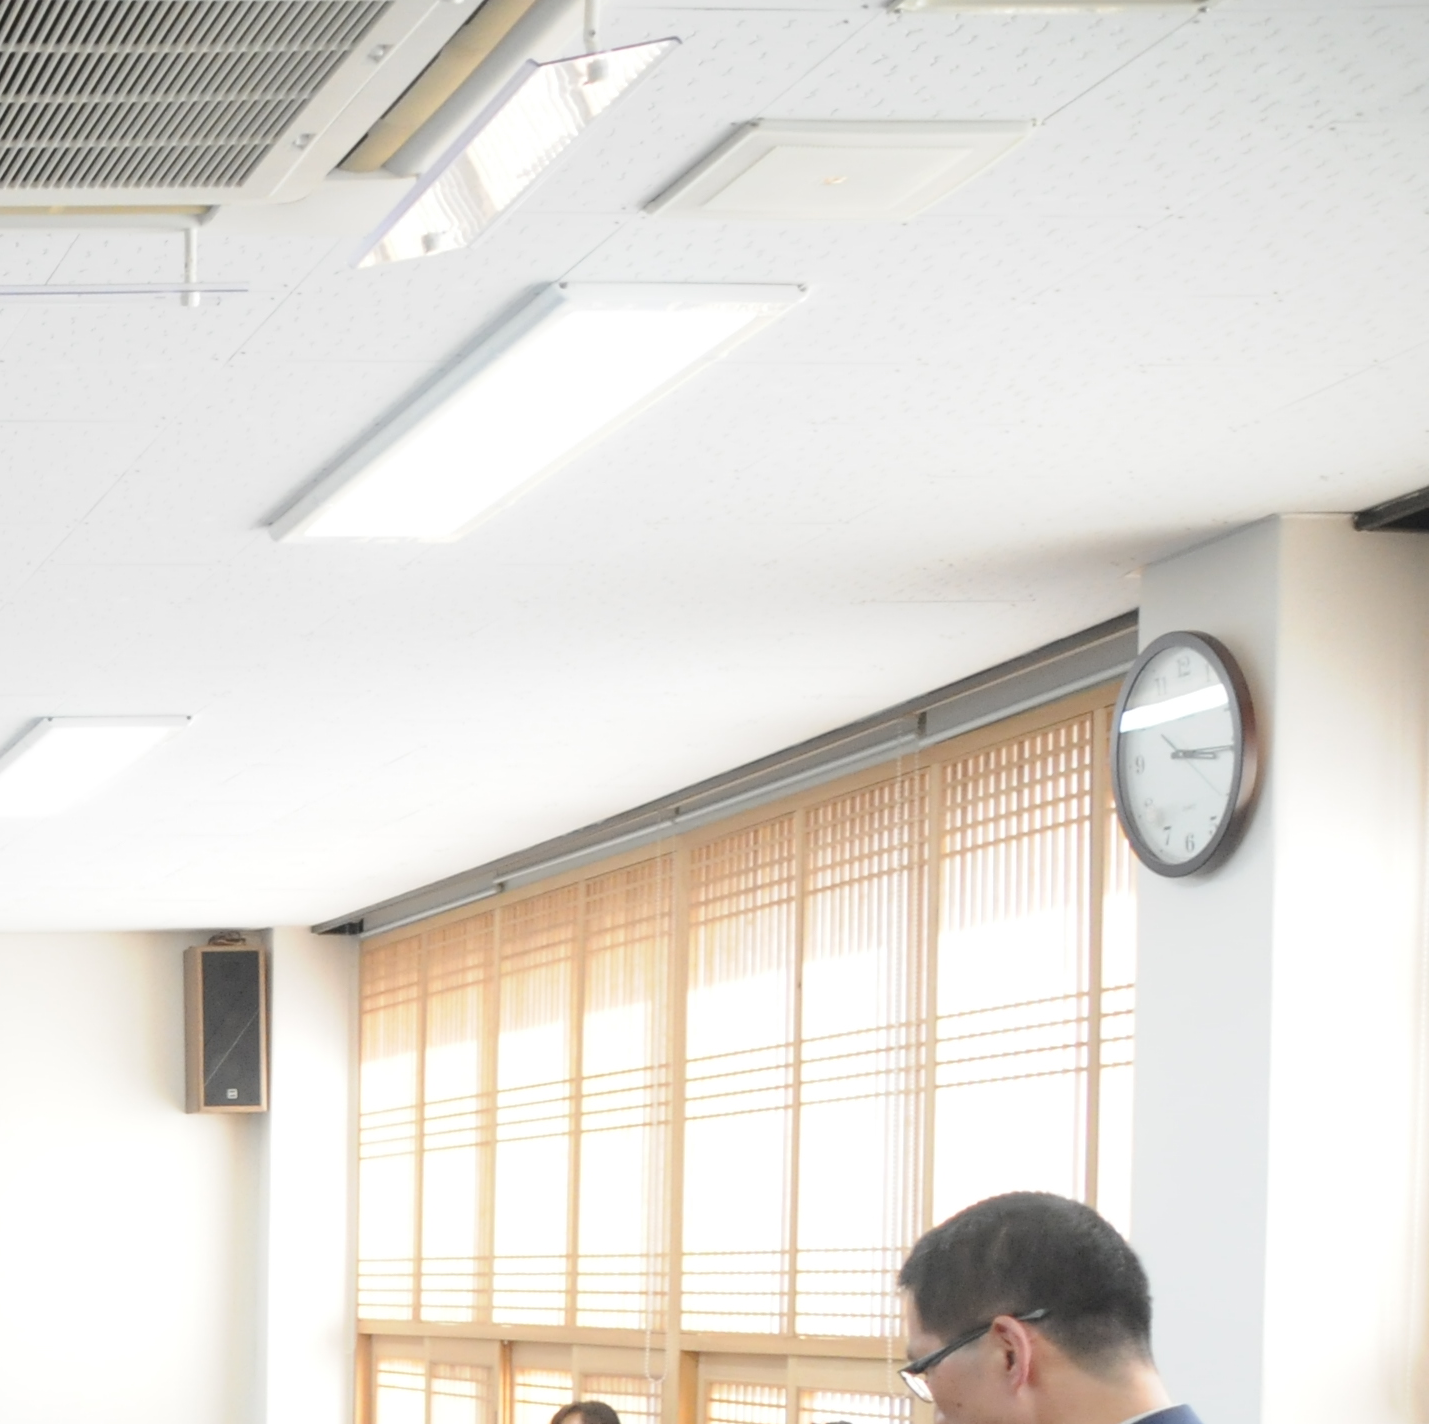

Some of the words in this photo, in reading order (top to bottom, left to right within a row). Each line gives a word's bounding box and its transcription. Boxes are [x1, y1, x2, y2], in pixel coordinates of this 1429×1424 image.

[1177, 656, 1191, 678] 12
[1155, 676, 1166, 696] 11
[1136, 756, 1145, 774] 9
[1163, 825, 1172, 846] 7
[1185, 833, 1195, 853] 6
